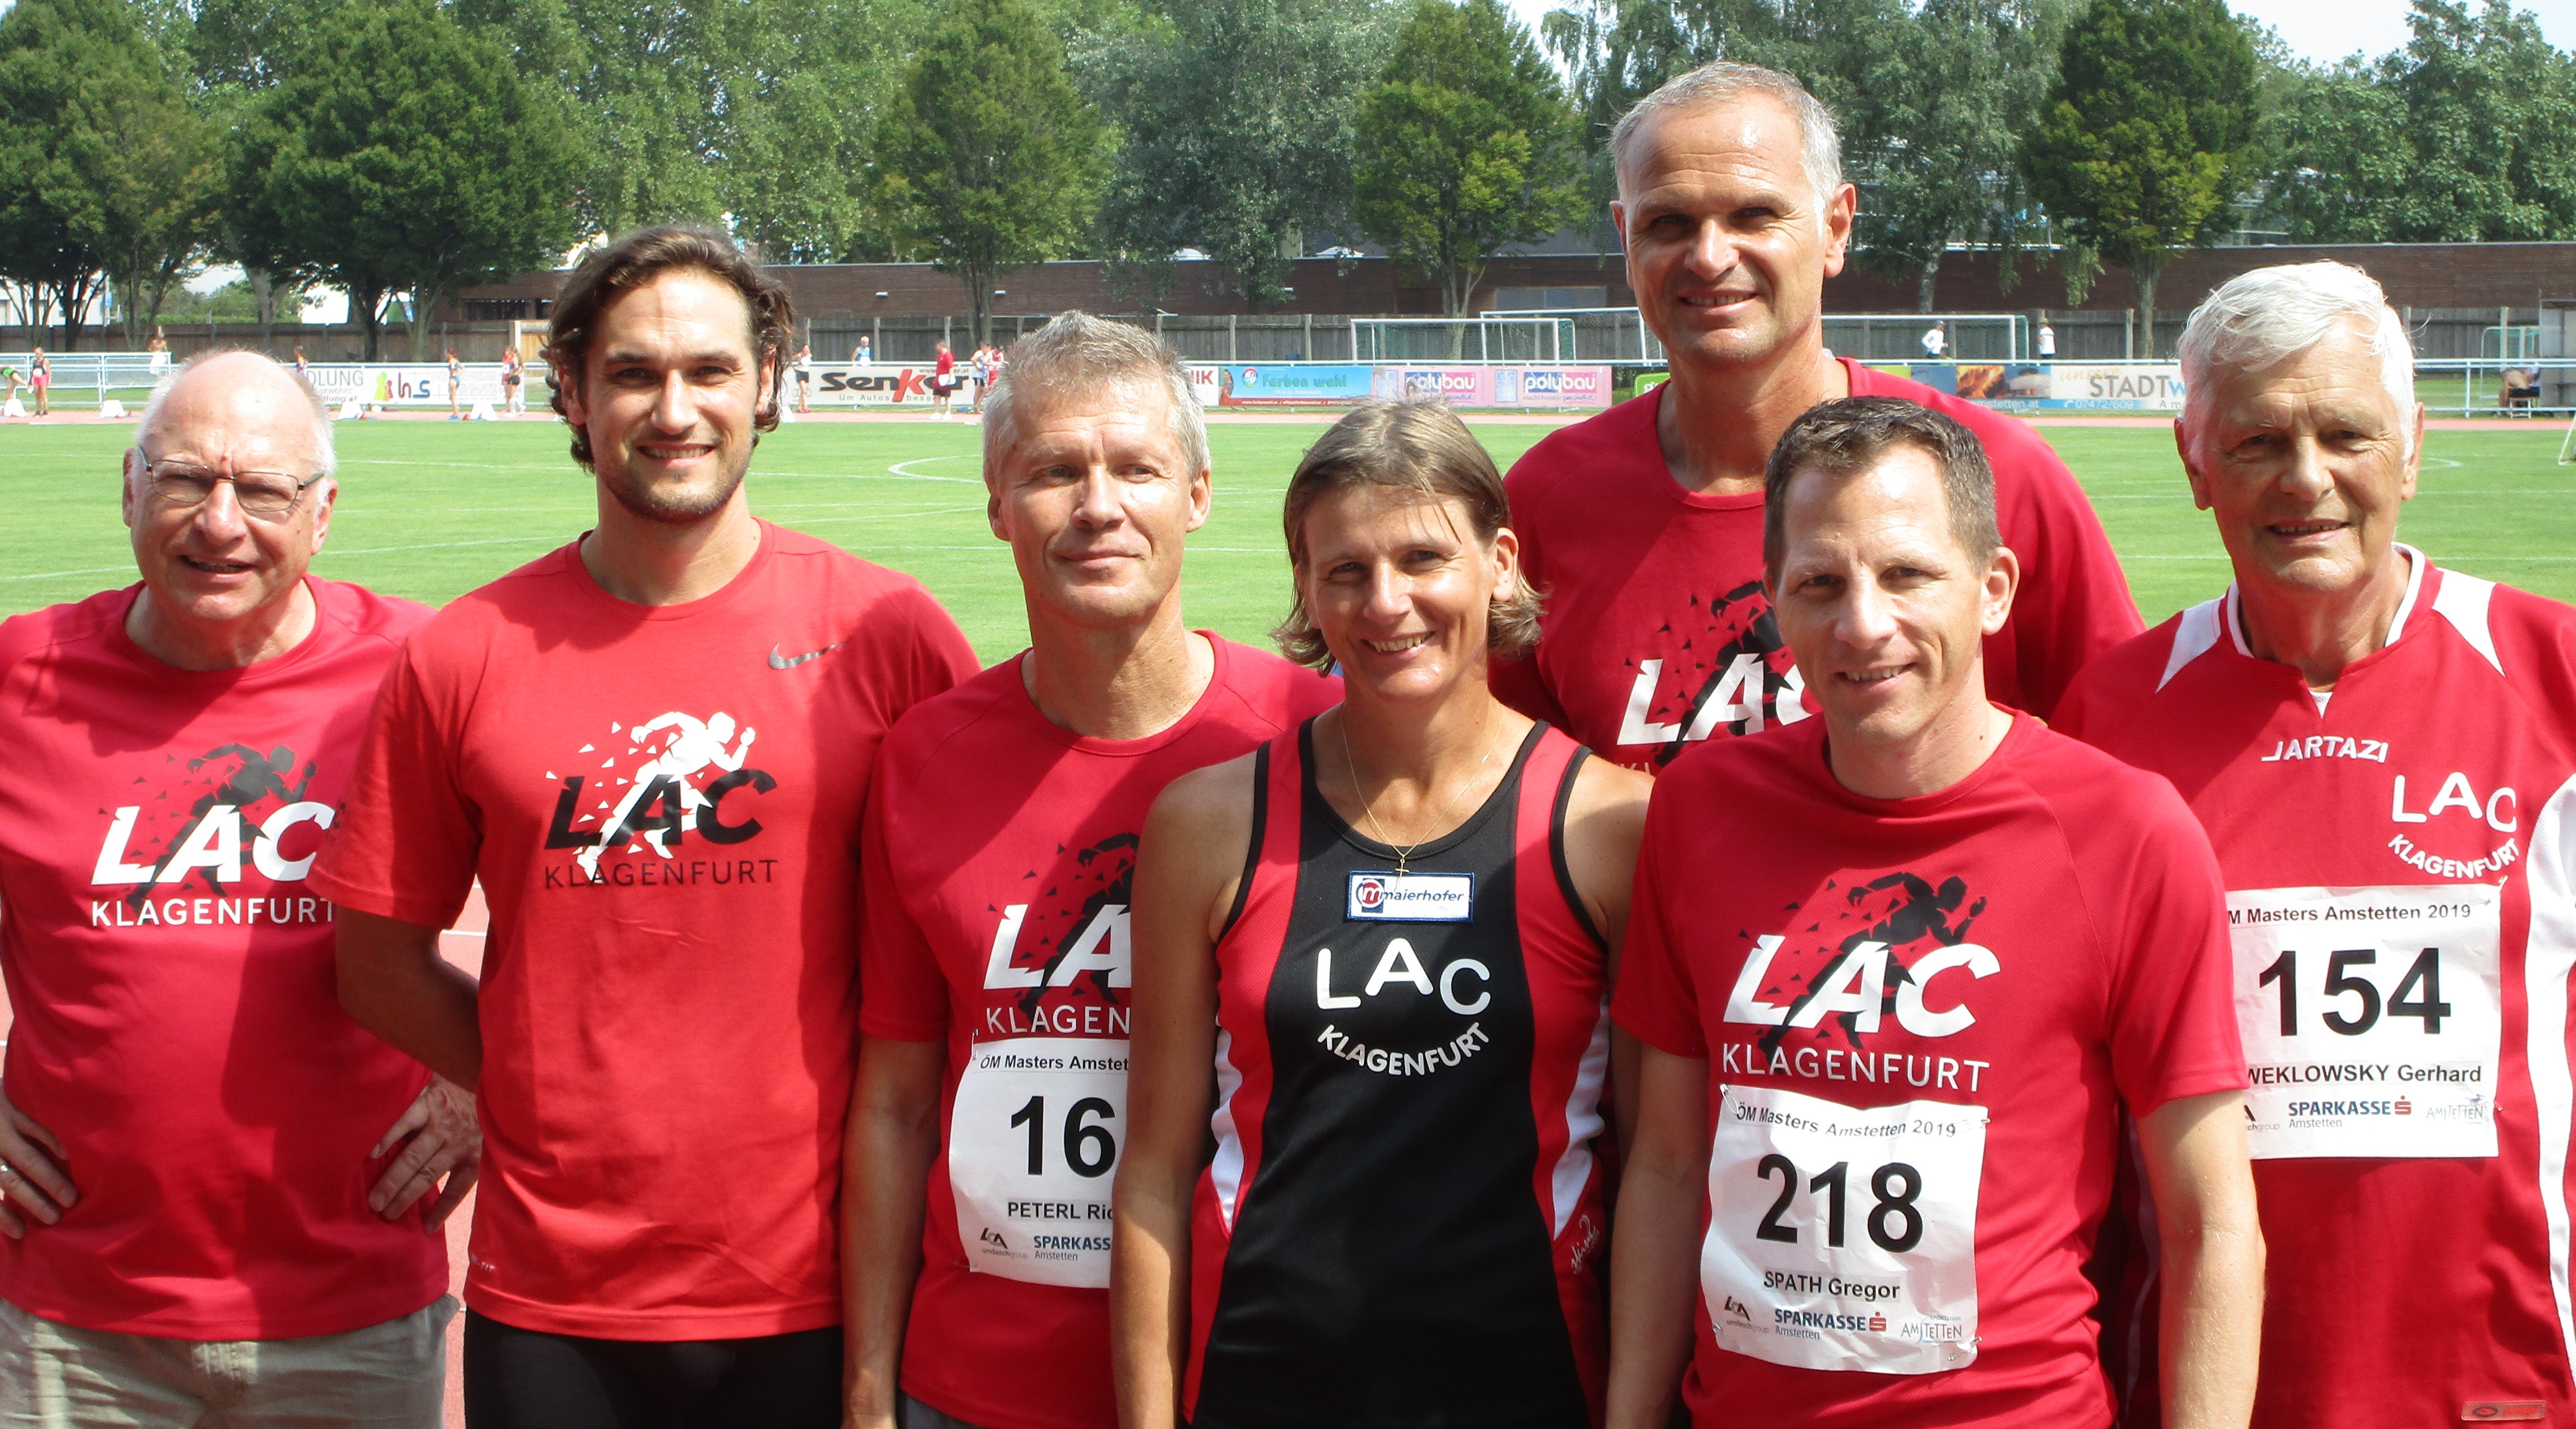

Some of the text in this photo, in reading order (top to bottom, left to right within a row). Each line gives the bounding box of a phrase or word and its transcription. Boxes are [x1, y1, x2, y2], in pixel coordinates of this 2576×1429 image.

[1314, 373, 1347, 387] wahl
[1525, 373, 1596, 393] polybau
[2159, 400, 2186, 409] Am
[2261, 736, 2388, 763] JARTAZI
[544, 769, 777, 849] LAC
[2392, 772, 2517, 833] LAC
[91, 801, 335, 885] LAC
[2388, 834, 2519, 879] KLAGENFURT
[544, 859, 778, 889] KLAGENFURT
[1380, 889, 1464, 901] maierhofer
[91, 897, 334, 926] KLAGENFURT
[2247, 907, 2318, 923] Masters
[2324, 905, 2421, 921] Amstetten
[2428, 904, 2471, 919] 2019
[983, 904, 1132, 989] LA
[1316, 938, 1491, 1016] LAC
[1723, 934, 2001, 1037] LAC
[2259, 947, 2451, 1036] 154
[986, 1005, 1131, 1034] KLAGEN
[980, 1054, 1129, 1071] ÖM Masters Amstet
[1317, 1022, 1490, 1076] KLAGENFURT
[1723, 1043, 1990, 1092] KLAGENFURT
[2397, 1064, 2482, 1082] Gerhard
[1736, 1102, 1956, 1138] ÖM Masters Amstetten 2019
[2288, 1101, 2391, 1117] SPARKASSE
[2288, 1118, 2343, 1129] Amstetten
[1011, 1095, 1116, 1179] 16
[2247, 1123, 2280, 1133] chgroup
[1007, 1201, 1081, 1220] PETERL
[1756, 1153, 1923, 1253] 218
[1033, 1235, 1112, 1251] SPARKASS
[1035, 1250, 1078, 1261] Amstetten
[1763, 1271, 1900, 1302] SPATH Gregor
[1774, 1309, 1866, 1331] SPARKASSE
[1775, 1325, 1821, 1340] Amstetten
